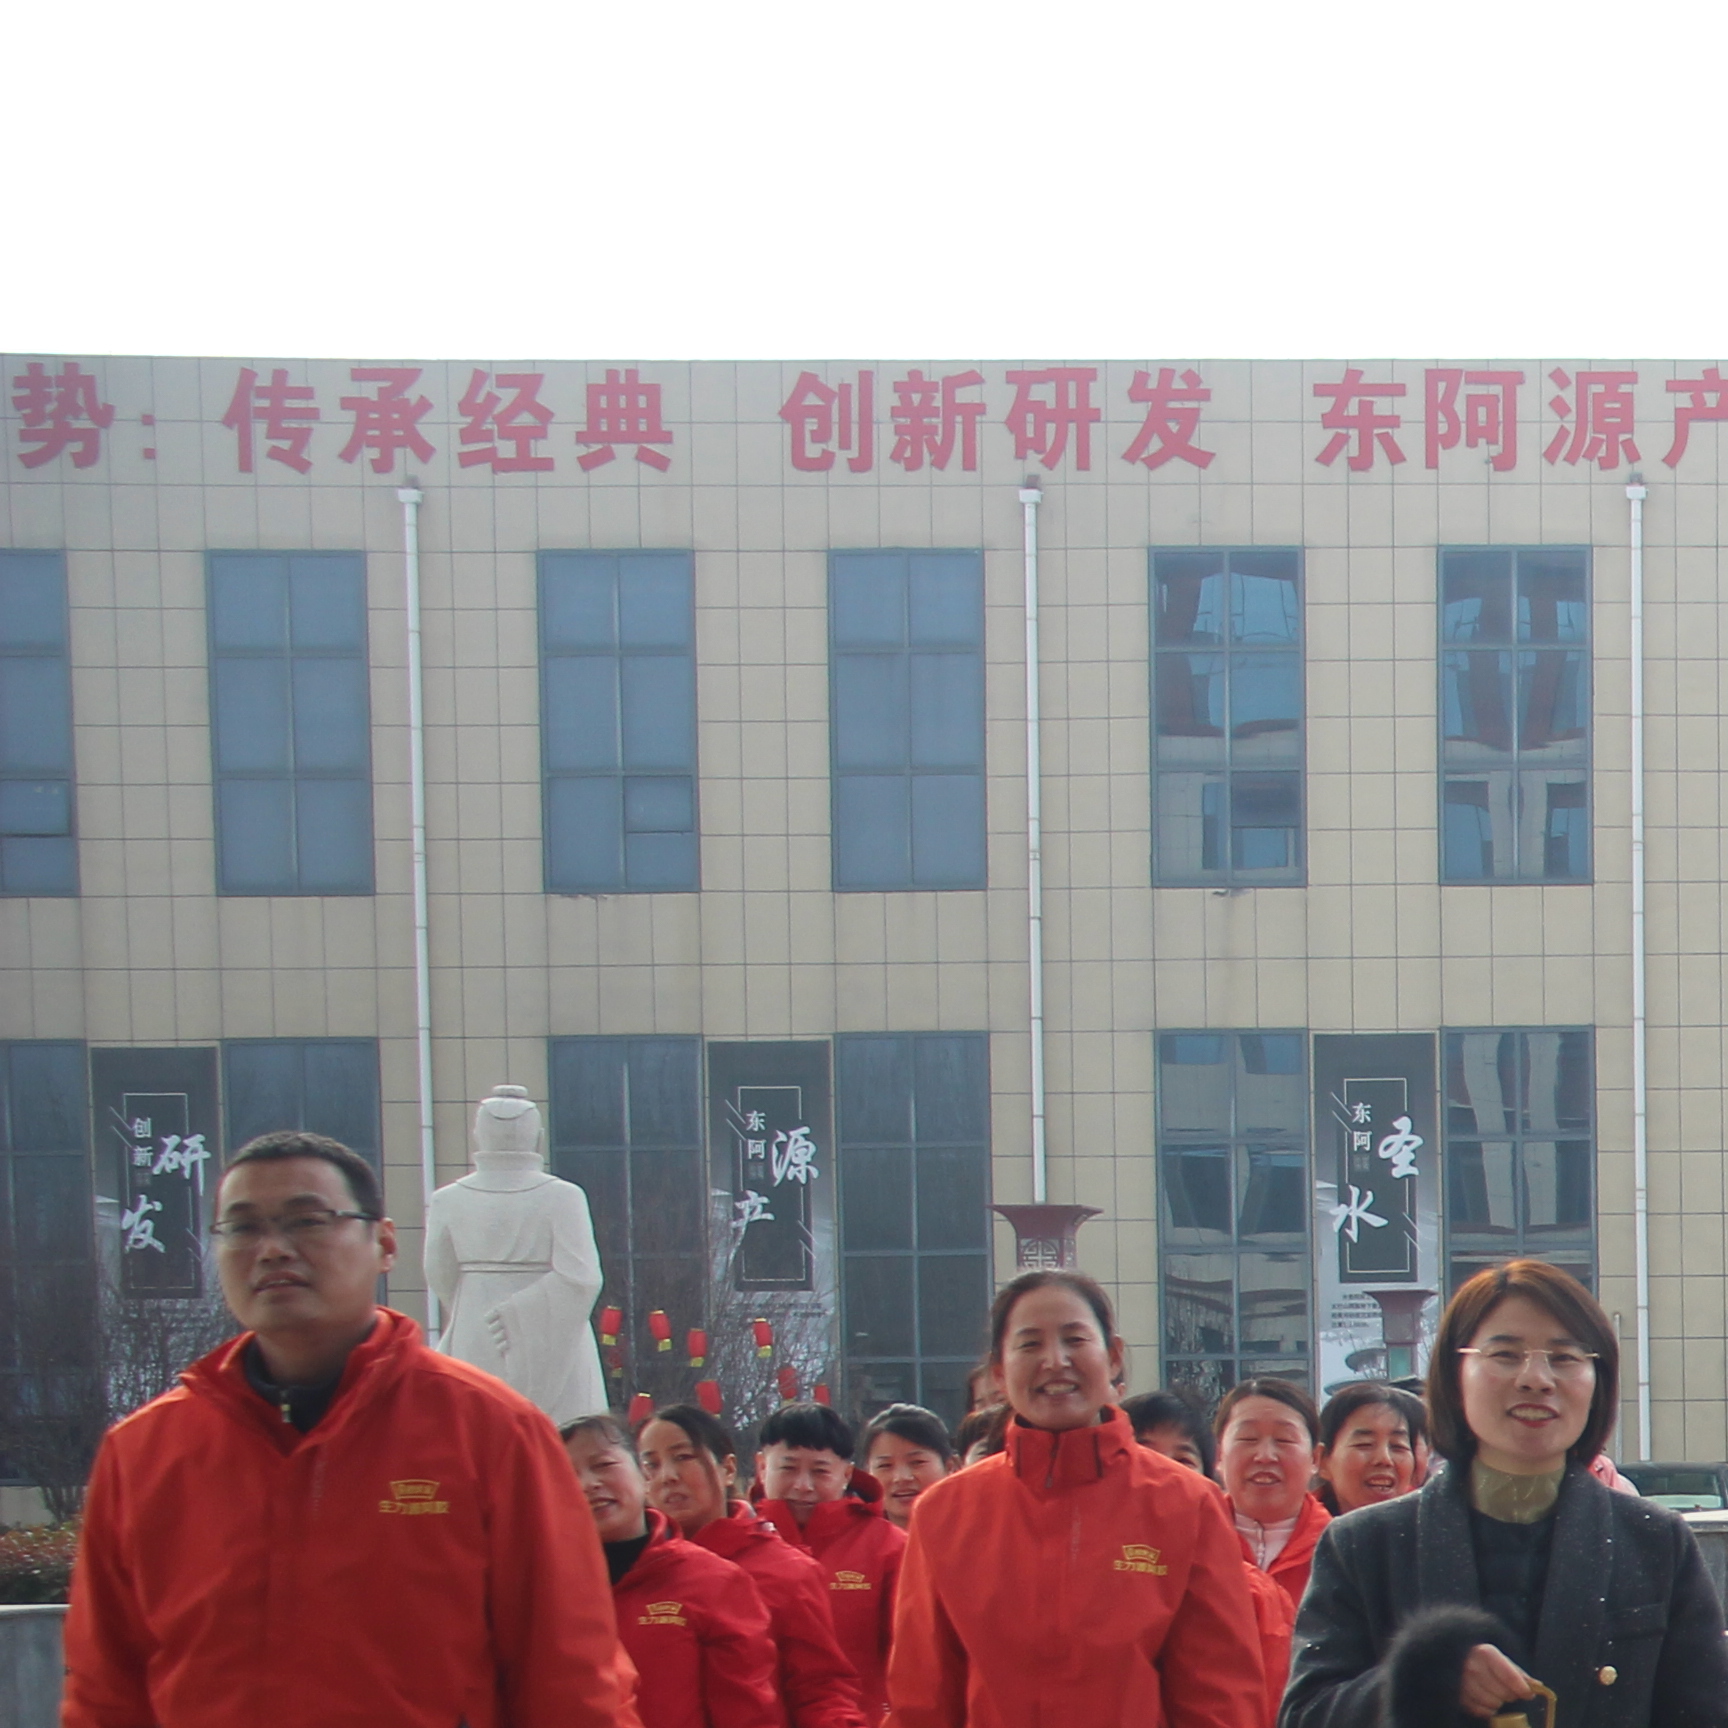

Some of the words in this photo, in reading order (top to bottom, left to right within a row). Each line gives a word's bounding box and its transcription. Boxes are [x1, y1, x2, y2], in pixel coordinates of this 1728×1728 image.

[221, 366, 675, 472] 传承经典
[779, 366, 1217, 473] 创新研发
[746, 1109, 766, 1160] 东阿
[1352, 1102, 1372, 1152] 东阿
